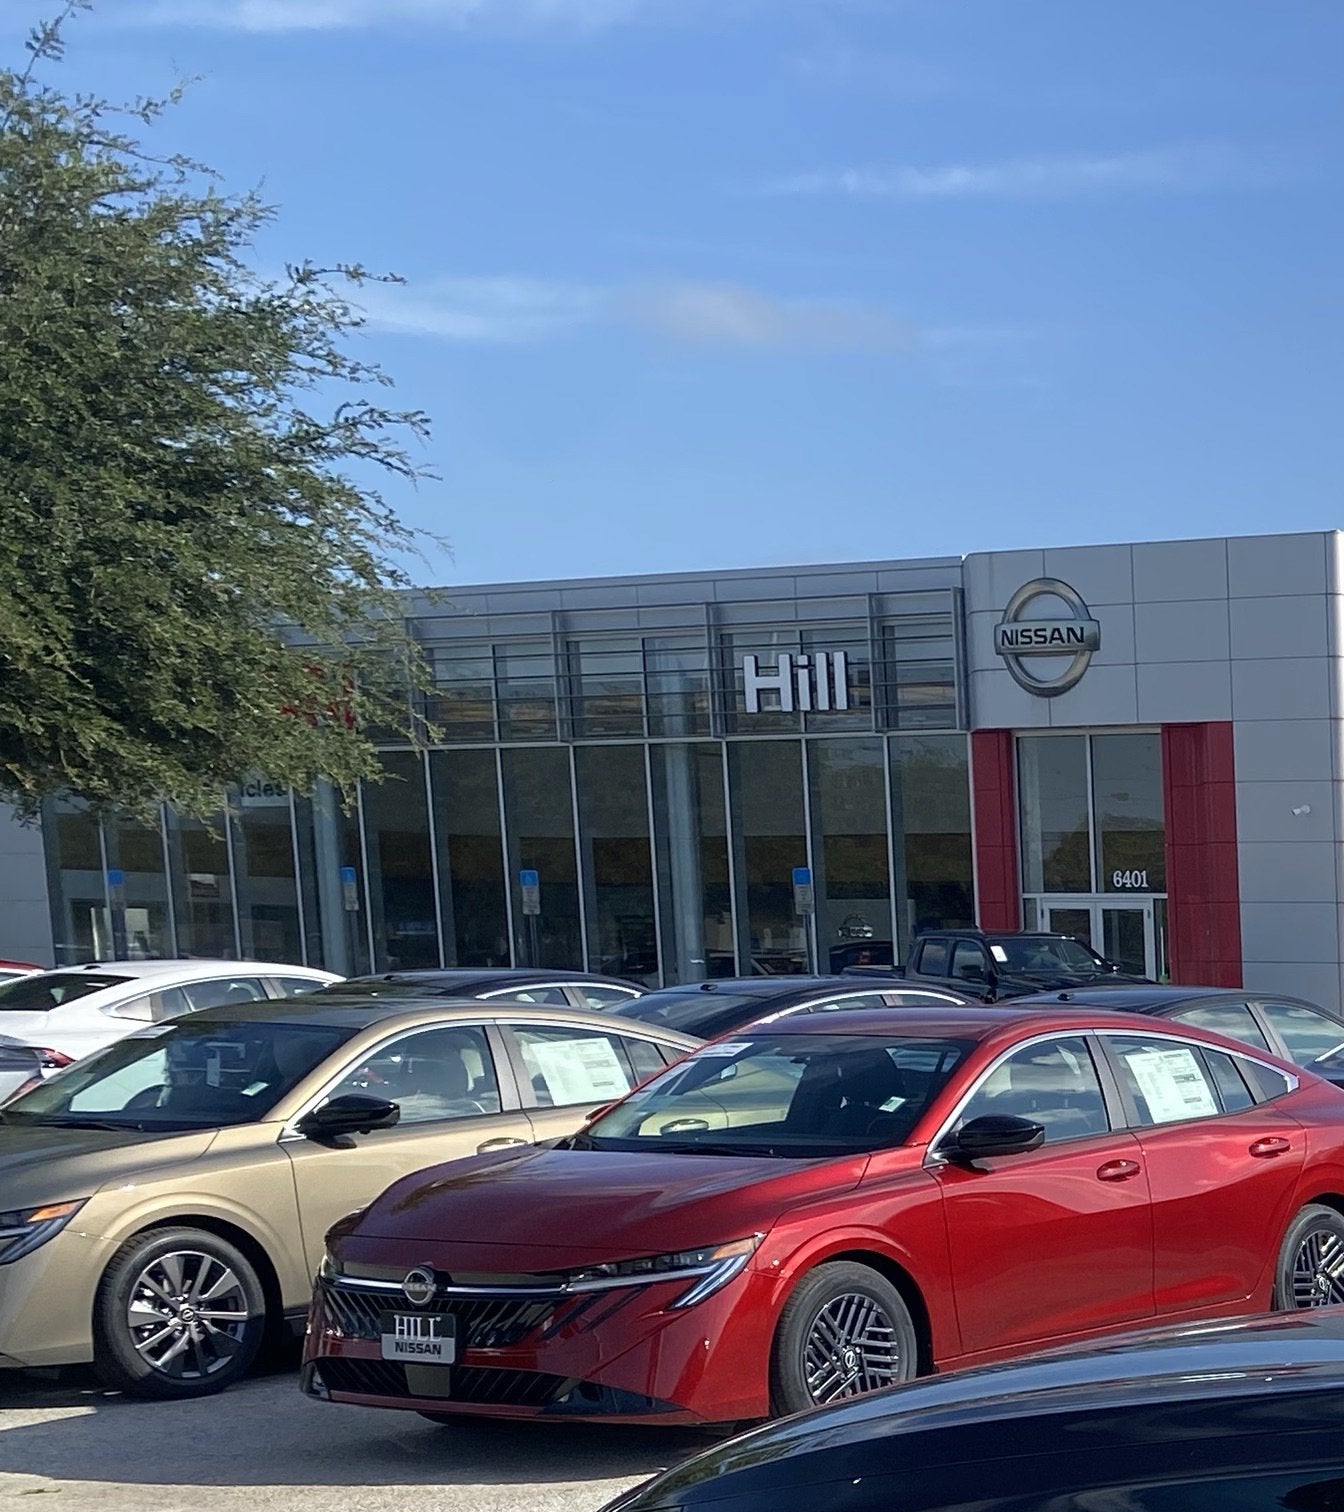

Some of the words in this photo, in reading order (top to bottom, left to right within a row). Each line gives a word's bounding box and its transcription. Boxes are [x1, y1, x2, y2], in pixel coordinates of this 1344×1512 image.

[1001, 626, 1085, 647] NISSAN
[743, 650, 848, 714] Hill
[1113, 870, 1149, 888] 6401
[394, 1314, 441, 1342] HILL
[394, 1341, 442, 1356] NISSAN
